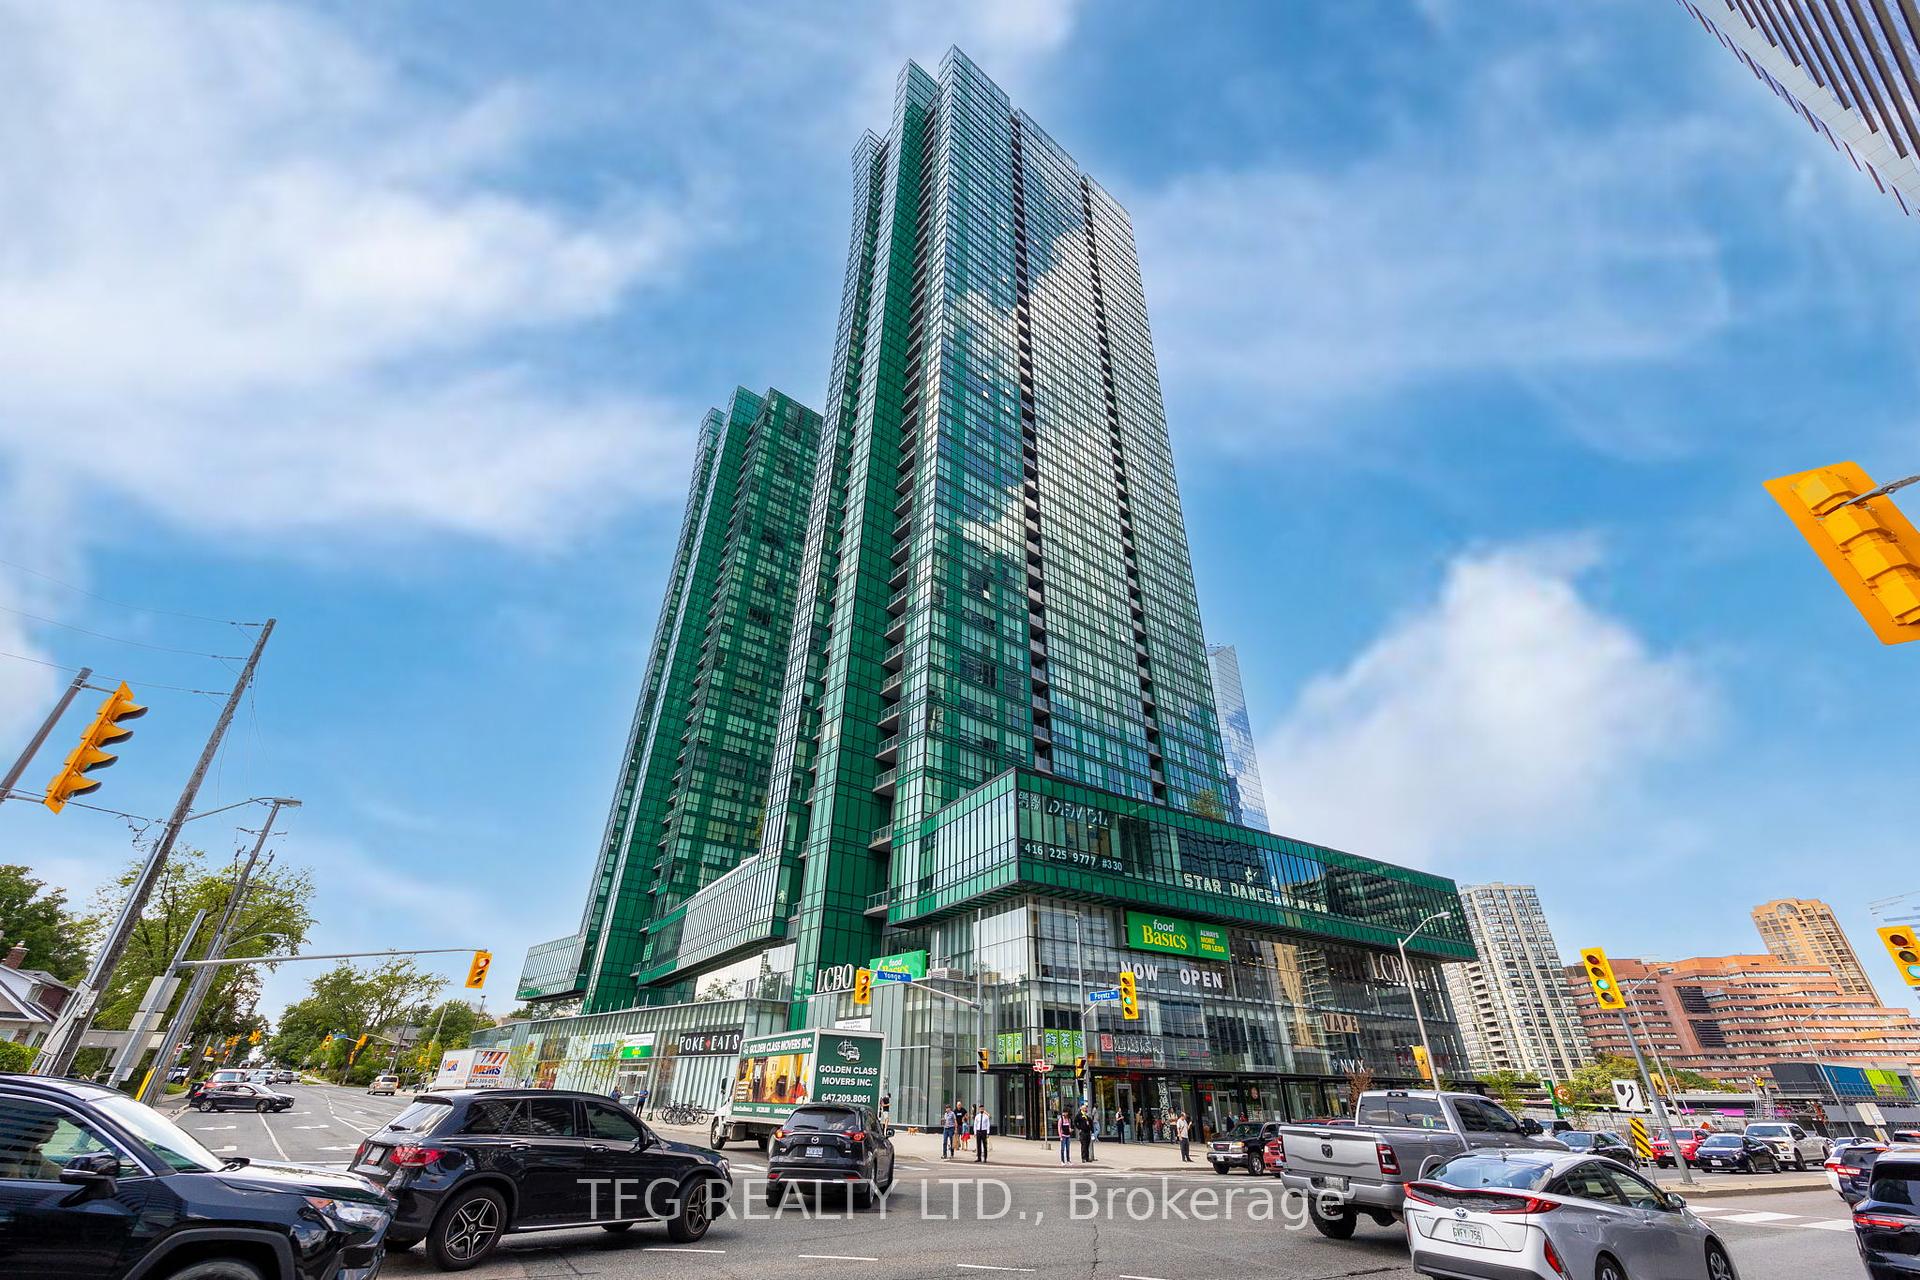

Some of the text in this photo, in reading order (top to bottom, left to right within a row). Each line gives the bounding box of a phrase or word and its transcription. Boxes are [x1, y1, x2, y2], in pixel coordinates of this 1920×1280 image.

[1047, 800, 1108, 826] DENTAL
[1025, 843, 1123, 871] 416 225 9777 #330
[1183, 873, 1273, 903] STAR DANCE
[1153, 919, 1174, 932] food
[1200, 930, 1219, 939] ALWAYS
[1200, 937, 1216, 945] MORE
[1212, 945, 1225, 953] LESS
[816, 964, 854, 993] LCBO
[883, 972, 902, 981] Yonge
[1121, 961, 1223, 989] NOW OPEN
[1323, 1014, 1357, 1032] VAPE
[679, 1034, 740, 1054] POKE EATS
[749, 1037, 813, 1054] GOLDEN CLASS MOVERS INC.
[819, 1064, 878, 1075] GOLDEN CLASS
[821, 1077, 873, 1087] MOVERS INC.
